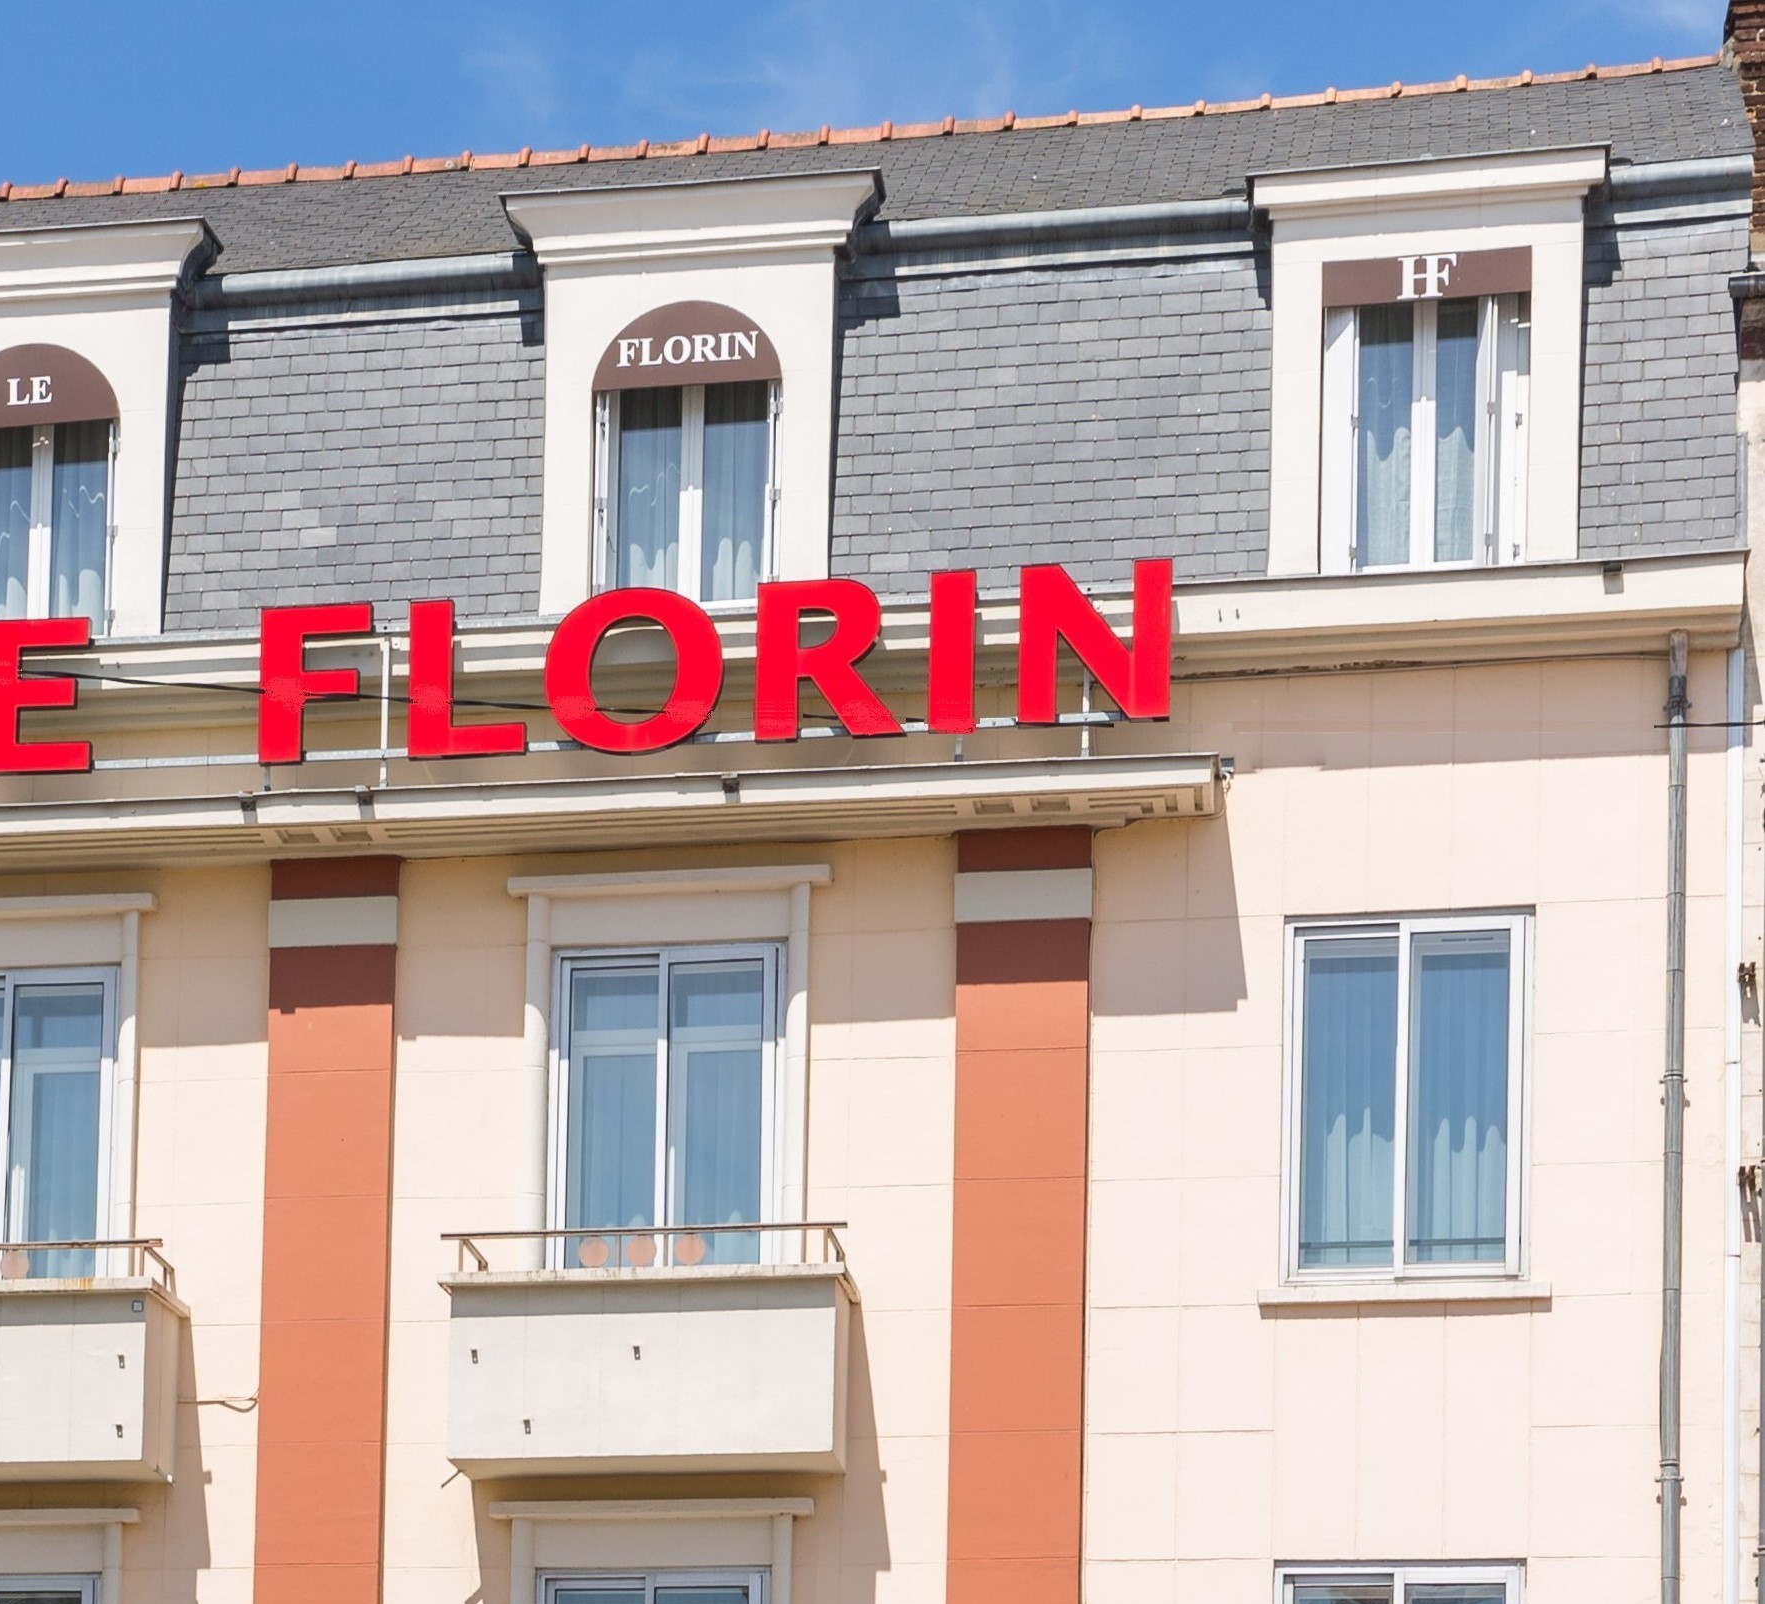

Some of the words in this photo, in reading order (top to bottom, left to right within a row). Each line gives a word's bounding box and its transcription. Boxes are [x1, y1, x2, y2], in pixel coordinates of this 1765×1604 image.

[1397, 253, 1457, 300] HF
[616, 331, 759, 367] FLORIN
[7, 376, 53, 406] LE
[258, 559, 1173, 765] FLORIN
